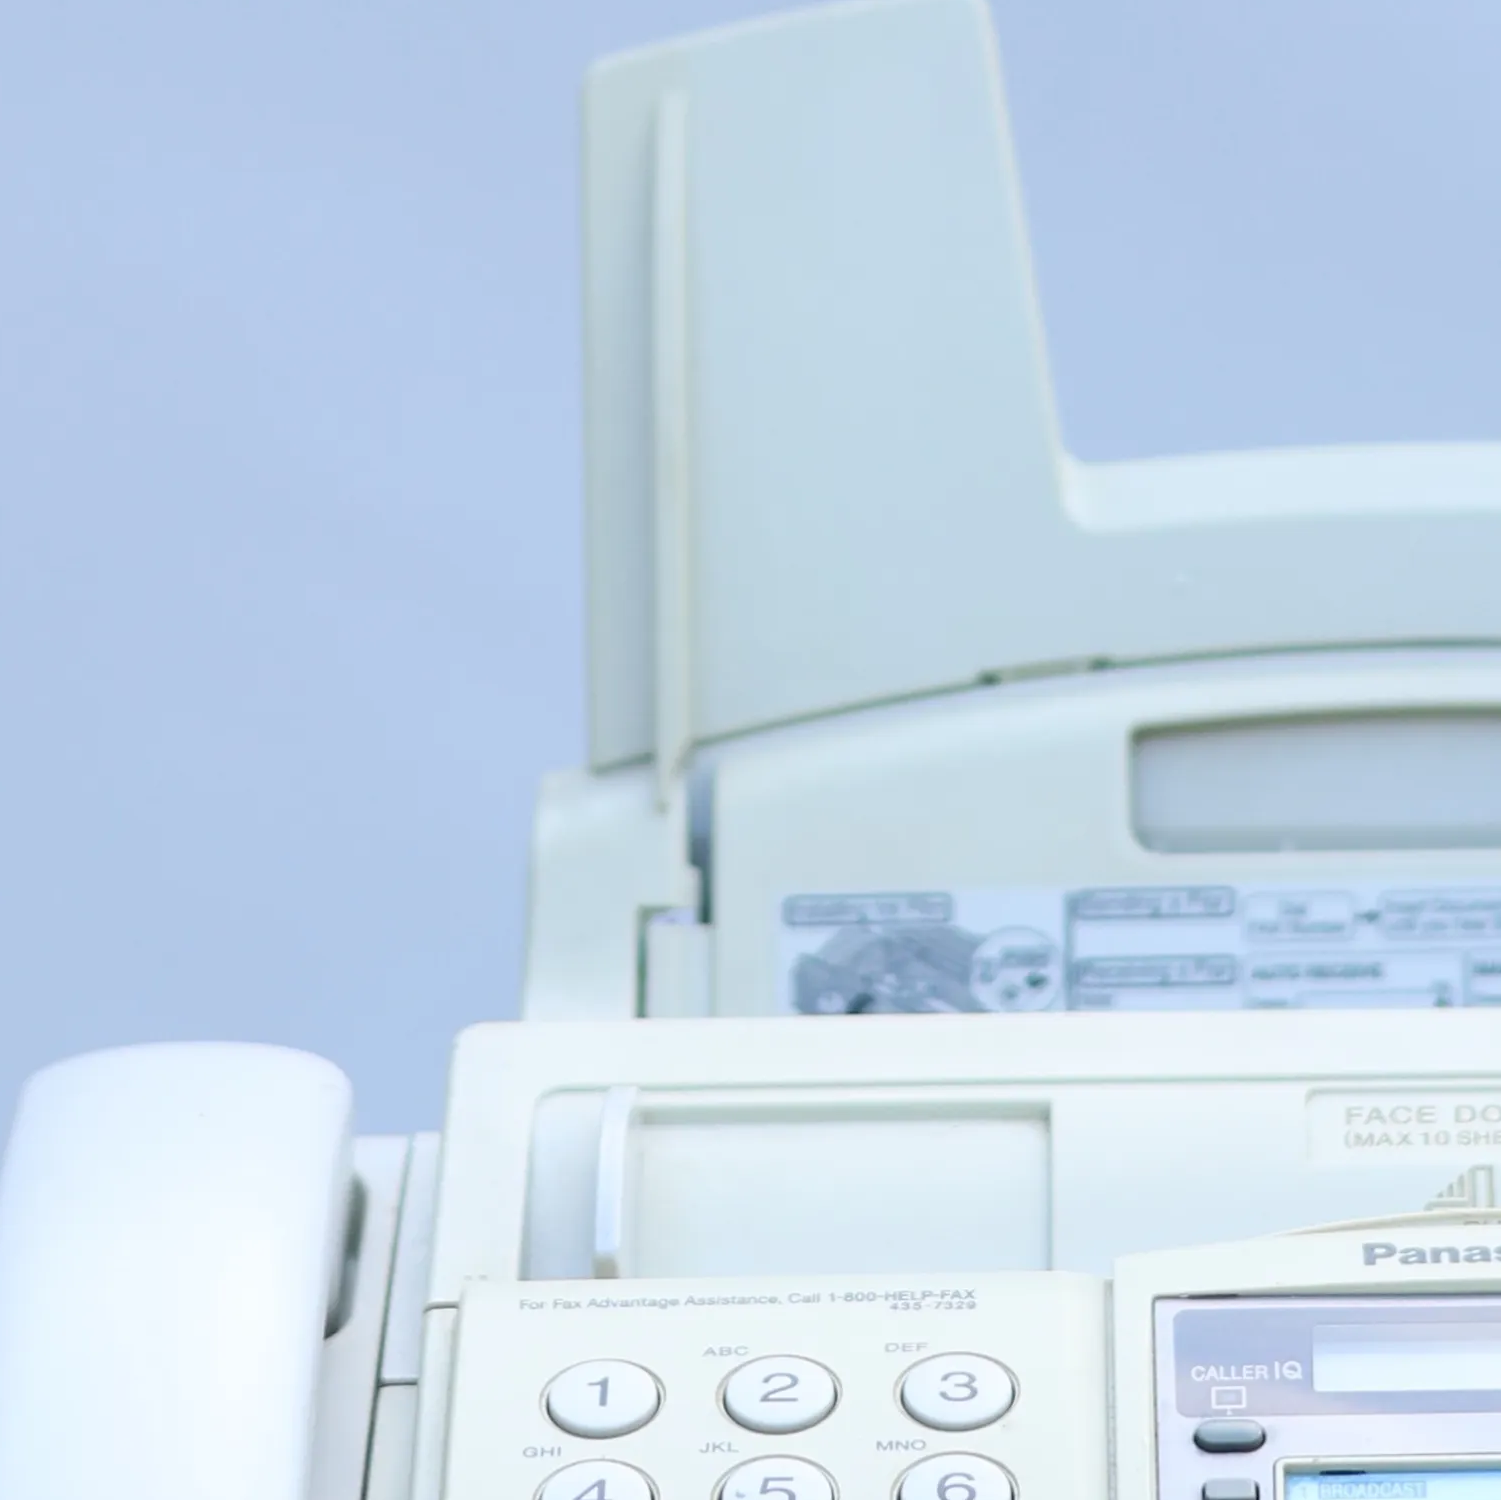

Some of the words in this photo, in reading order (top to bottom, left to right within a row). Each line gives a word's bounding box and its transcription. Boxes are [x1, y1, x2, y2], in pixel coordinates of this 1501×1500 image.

[1345, 1105, 1436, 1126] FACE
[1343, 1130, 1412, 1149] (MAX
[519, 1298, 547, 1310] For
[552, 1297, 581, 1310] Fax
[587, 1297, 680, 1309] Advantage
[787, 1292, 821, 1304] Call
[827, 1288, 976, 1302] 1-800-HELP-FAX
[702, 1345, 749, 1356] ABC
[884, 1341, 929, 1353] DEF
[1190, 1364, 1269, 1381] CALLER
[587, 1376, 609, 1407] 1
[759, 1373, 800, 1403] 2
[938, 1371, 979, 1402] 3
[523, 1446, 561, 1457] GHI
[699, 1441, 739, 1453] JKL
[876, 1439, 927, 1451] MNO
[1320, 1482, 1425, 1500] BROADCAST
